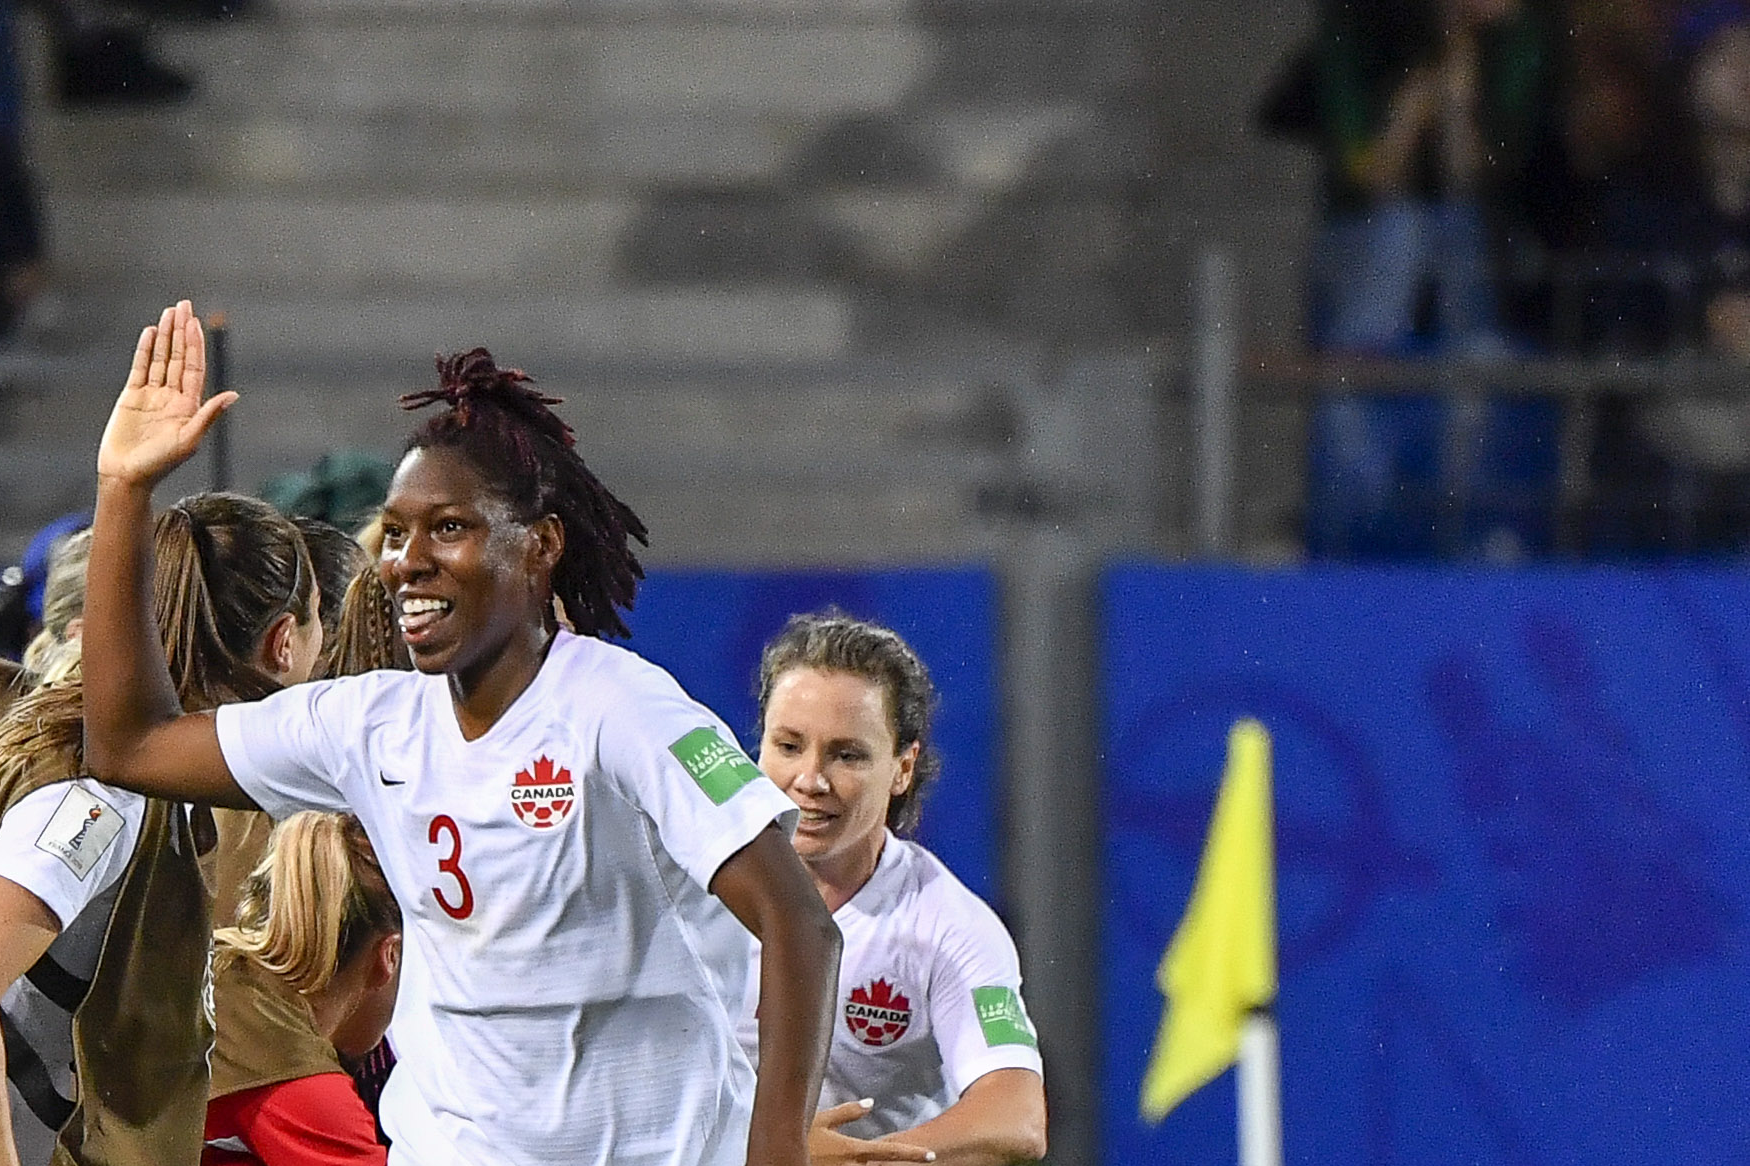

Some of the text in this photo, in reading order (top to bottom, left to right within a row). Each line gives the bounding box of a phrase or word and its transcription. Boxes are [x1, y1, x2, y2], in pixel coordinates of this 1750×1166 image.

[511, 786, 575, 800] CANADA
[428, 814, 474, 920] 3
[845, 1004, 910, 1023] CANADA
